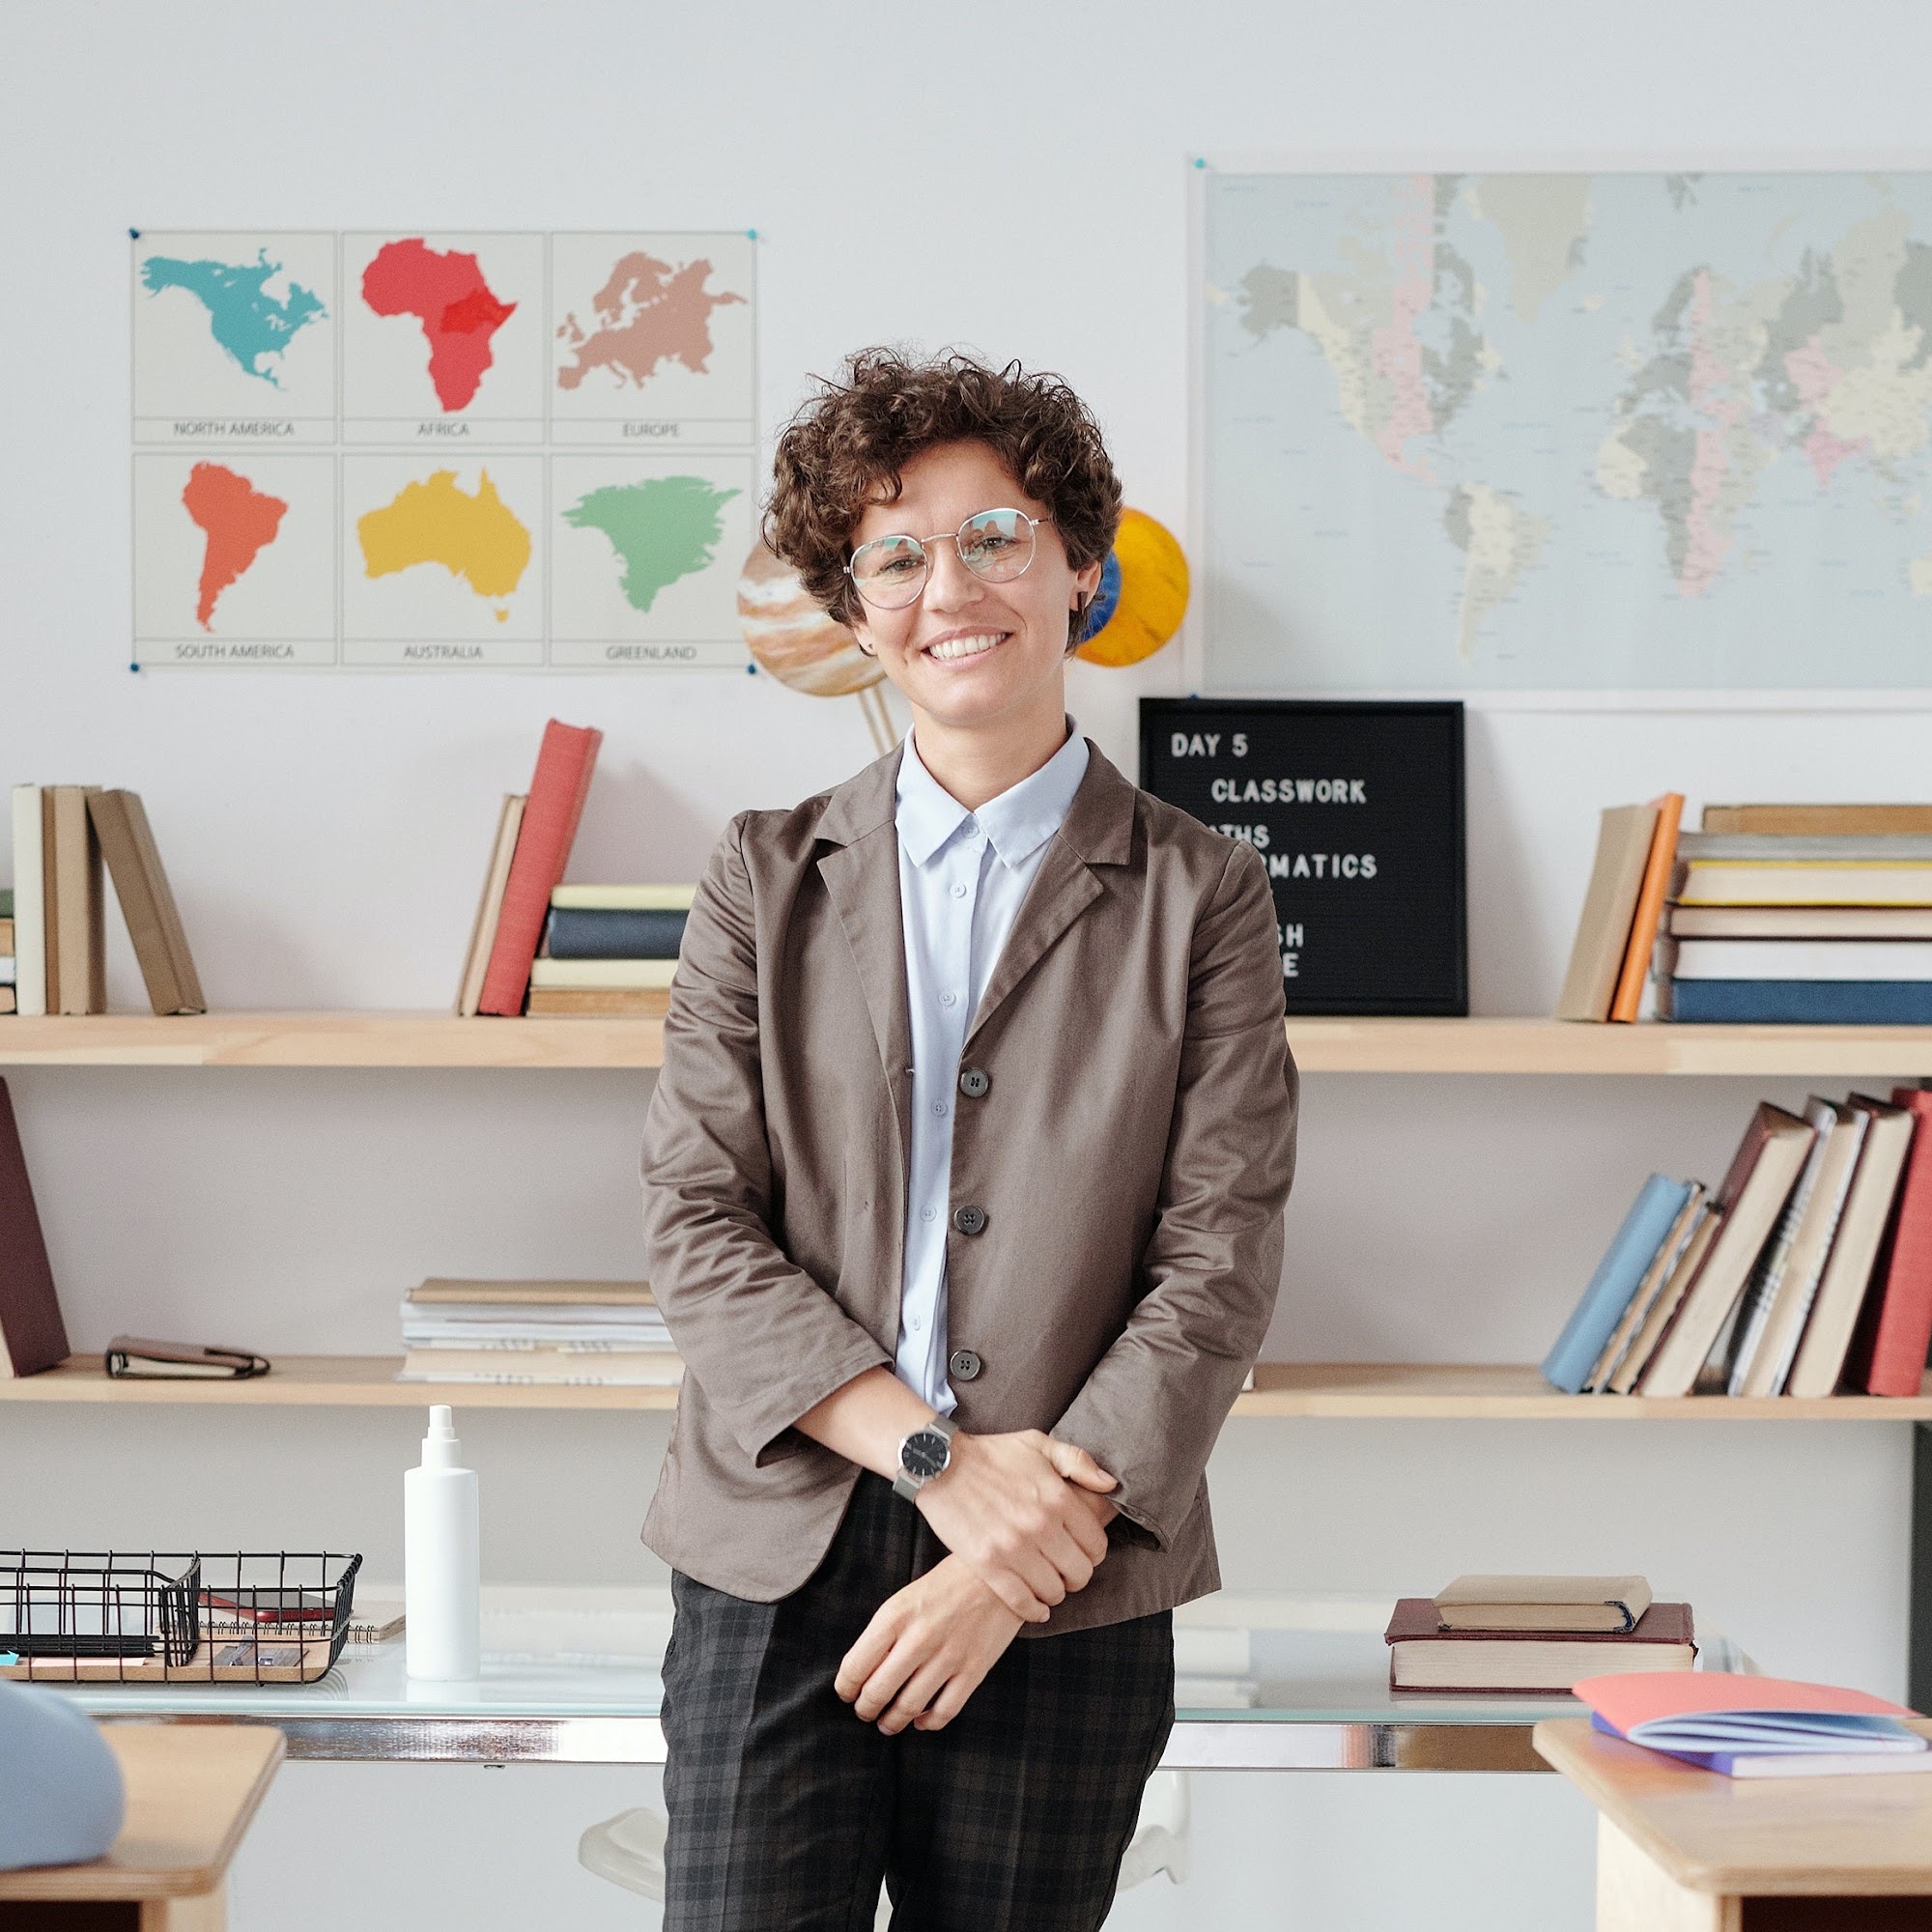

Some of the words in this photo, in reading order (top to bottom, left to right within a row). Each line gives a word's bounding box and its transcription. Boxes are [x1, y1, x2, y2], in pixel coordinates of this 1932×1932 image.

[174, 421, 226, 437] NORTH
[229, 421, 295, 437] AMERICA
[417, 421, 469, 437] AFRICA
[622, 423, 679, 438] EUROPE
[175, 643, 226, 659] SOUTH
[229, 643, 295, 659] AMERICA
[404, 644, 484, 659] AUSTRALIA
[605, 645, 697, 660] GREENLAND
[1171, 732, 1220, 757] DAY
[1232, 733, 1249, 757] 5
[1211, 779, 1367, 804] CLASSWORK
[1208, 824, 1270, 849] THS
[1260, 853, 1378, 879] MATICS
